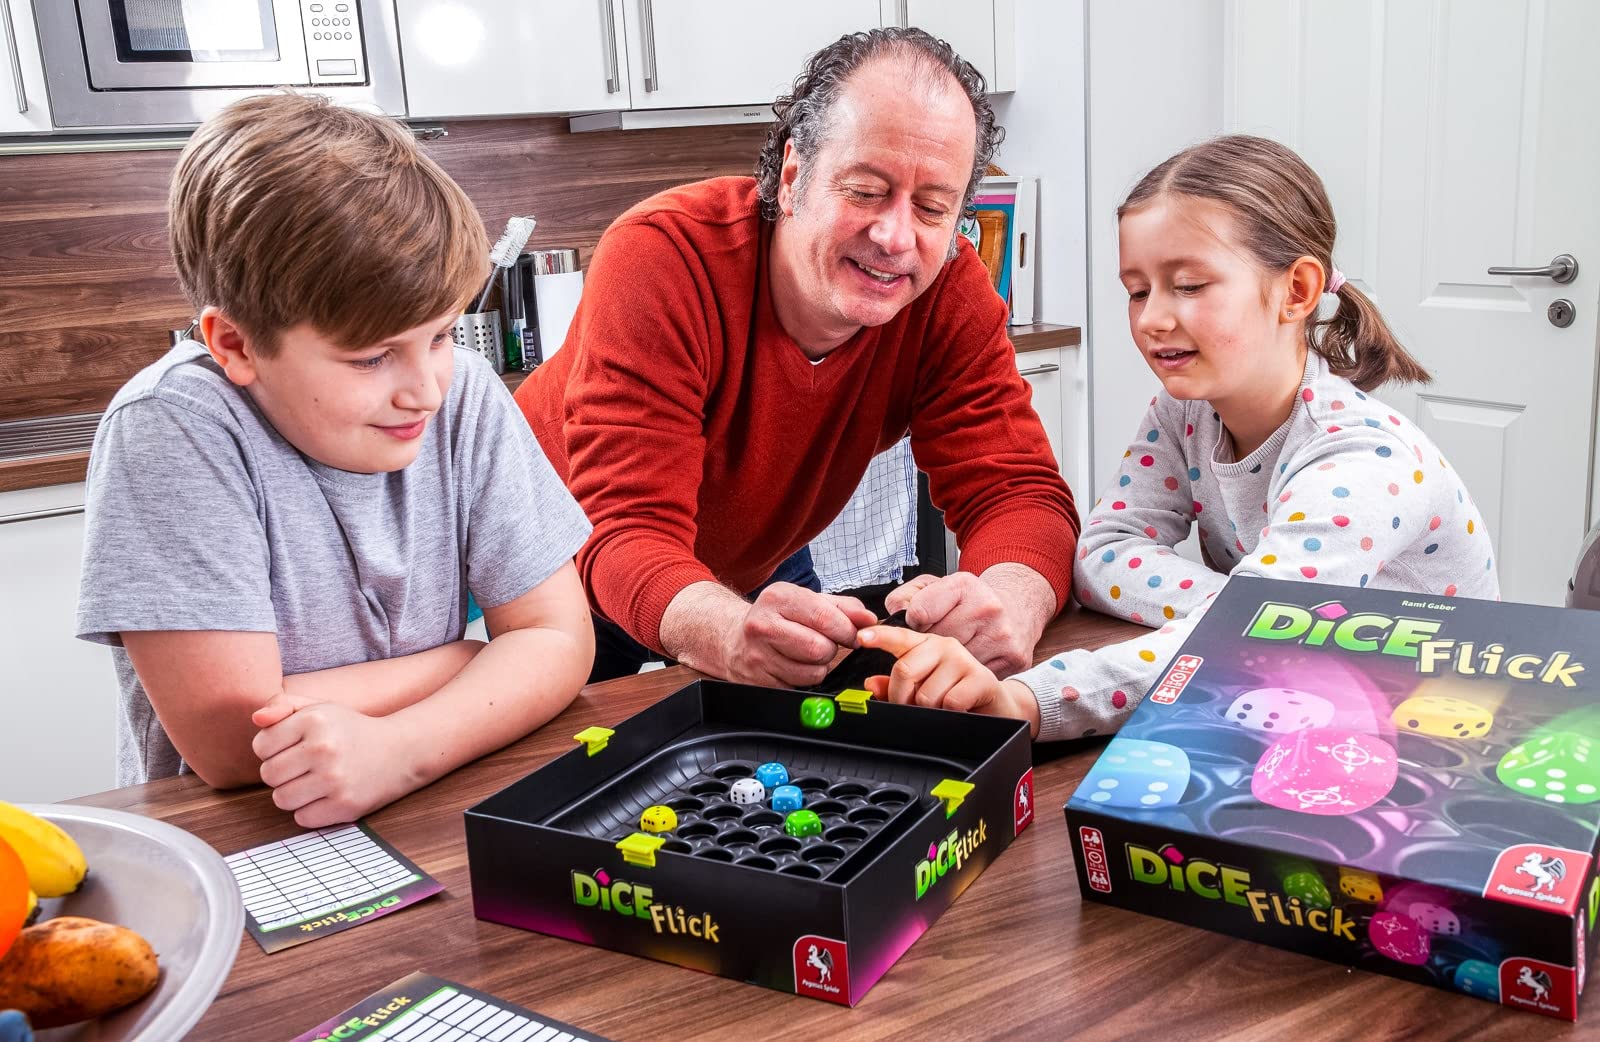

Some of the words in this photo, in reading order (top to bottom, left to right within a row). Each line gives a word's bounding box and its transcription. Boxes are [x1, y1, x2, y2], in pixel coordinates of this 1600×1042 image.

[1401, 600, 1427, 608] Rami
[1427, 602, 1456, 611] Gaber
[1418, 640, 1585, 688] Flick
[955, 818, 987, 870] Flick
[300, 911, 348, 932] Flick
[650, 904, 719, 944] Flick
[1246, 890, 1356, 941] Flick
[311, 1016, 369, 1042] iCE
[362, 996, 412, 1027] Flick
